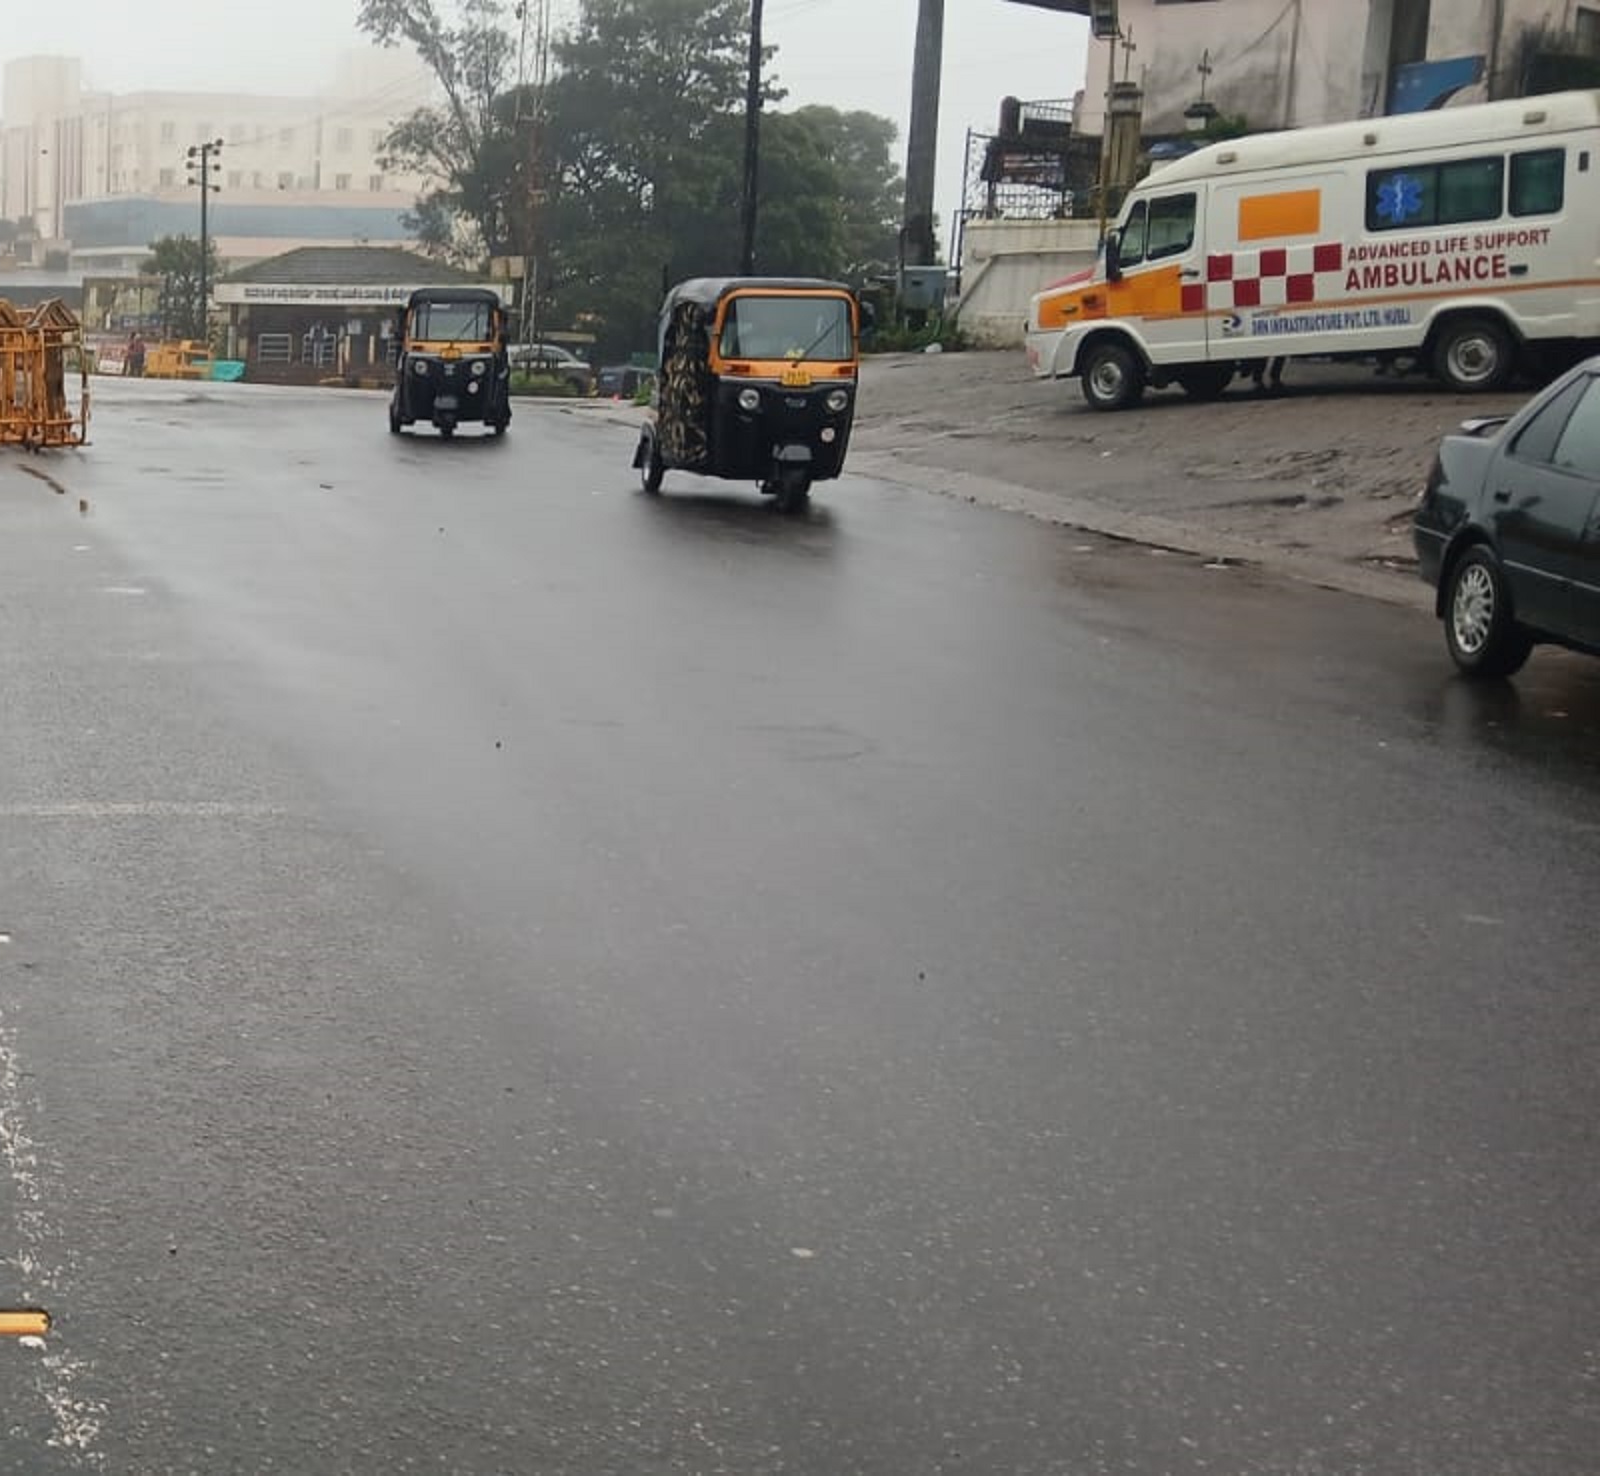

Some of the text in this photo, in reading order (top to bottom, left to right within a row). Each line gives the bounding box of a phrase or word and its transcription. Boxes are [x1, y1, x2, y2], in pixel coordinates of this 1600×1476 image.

[1347, 229, 1551, 262] ADVANCED LIFE SUPPORT
[1345, 254, 1508, 291] AMBULANCE
[1269, 312, 1342, 334] INFRASTRUCTURE
